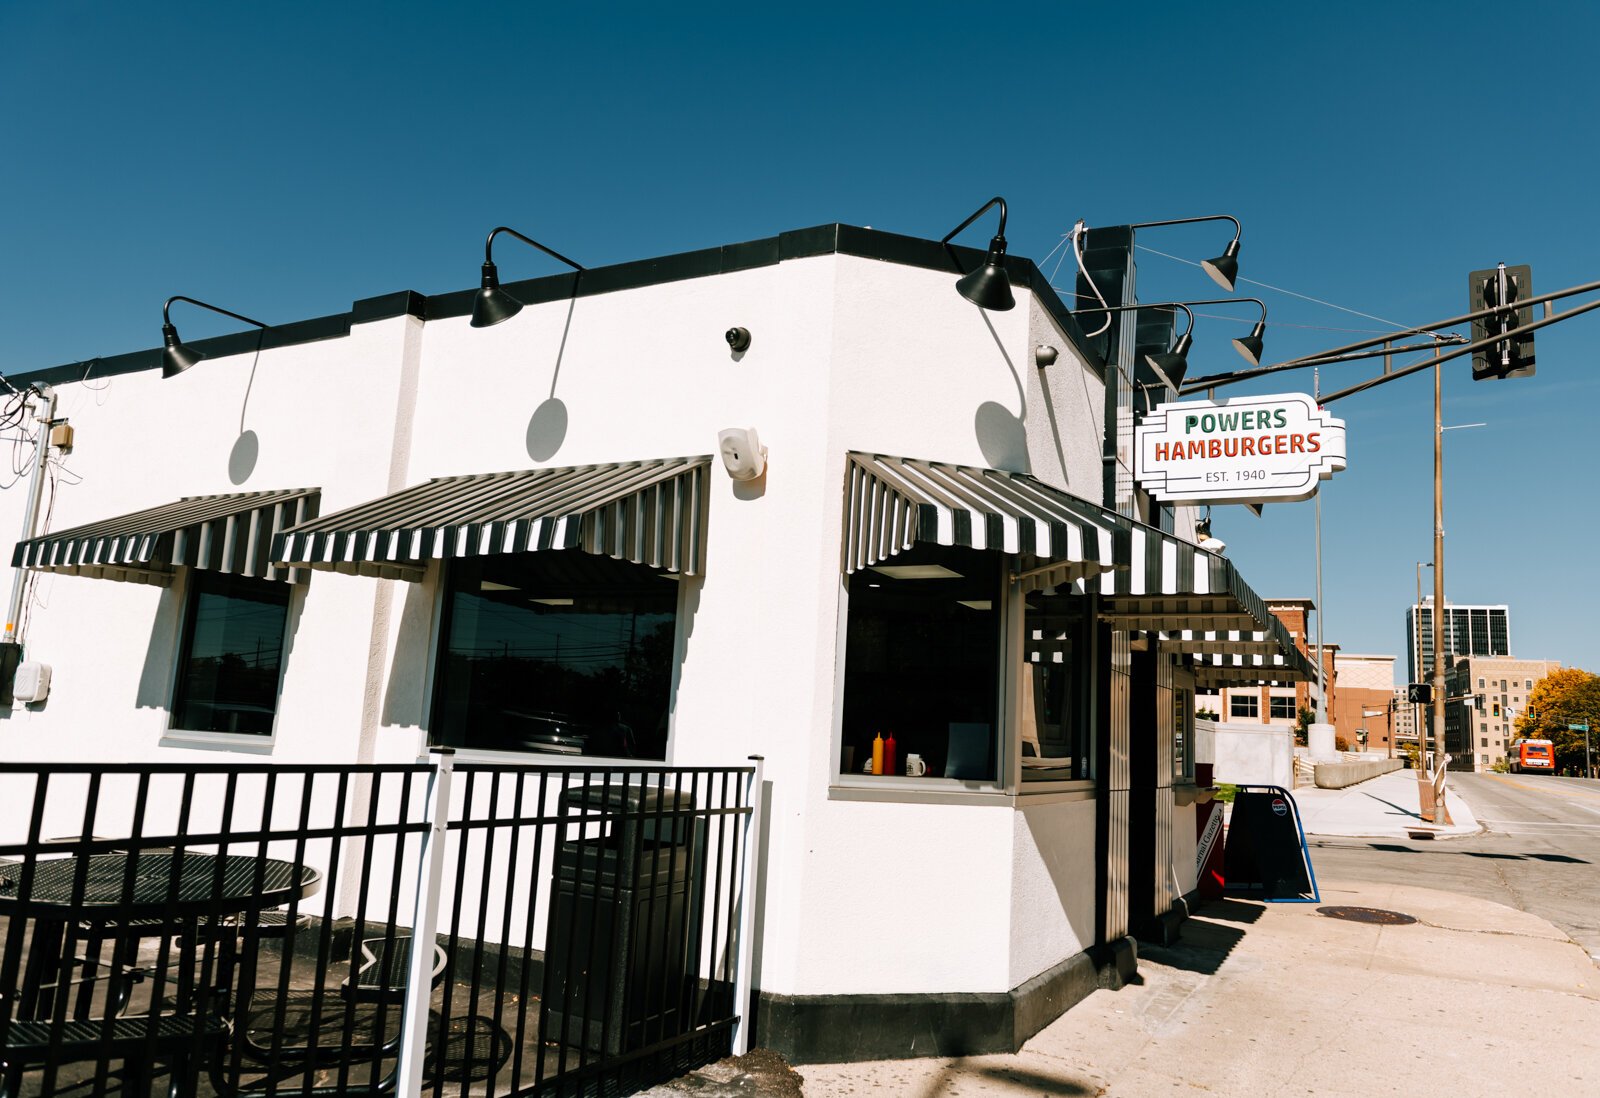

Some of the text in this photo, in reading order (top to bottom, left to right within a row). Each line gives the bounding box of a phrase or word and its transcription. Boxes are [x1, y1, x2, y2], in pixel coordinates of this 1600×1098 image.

[1185, 408, 1287, 434] POWERS
[1155, 432, 1321, 461] HAMBURGERS
[1206, 470, 1266, 482] EST. 1940
[1203, 815, 1219, 844] Gazette
